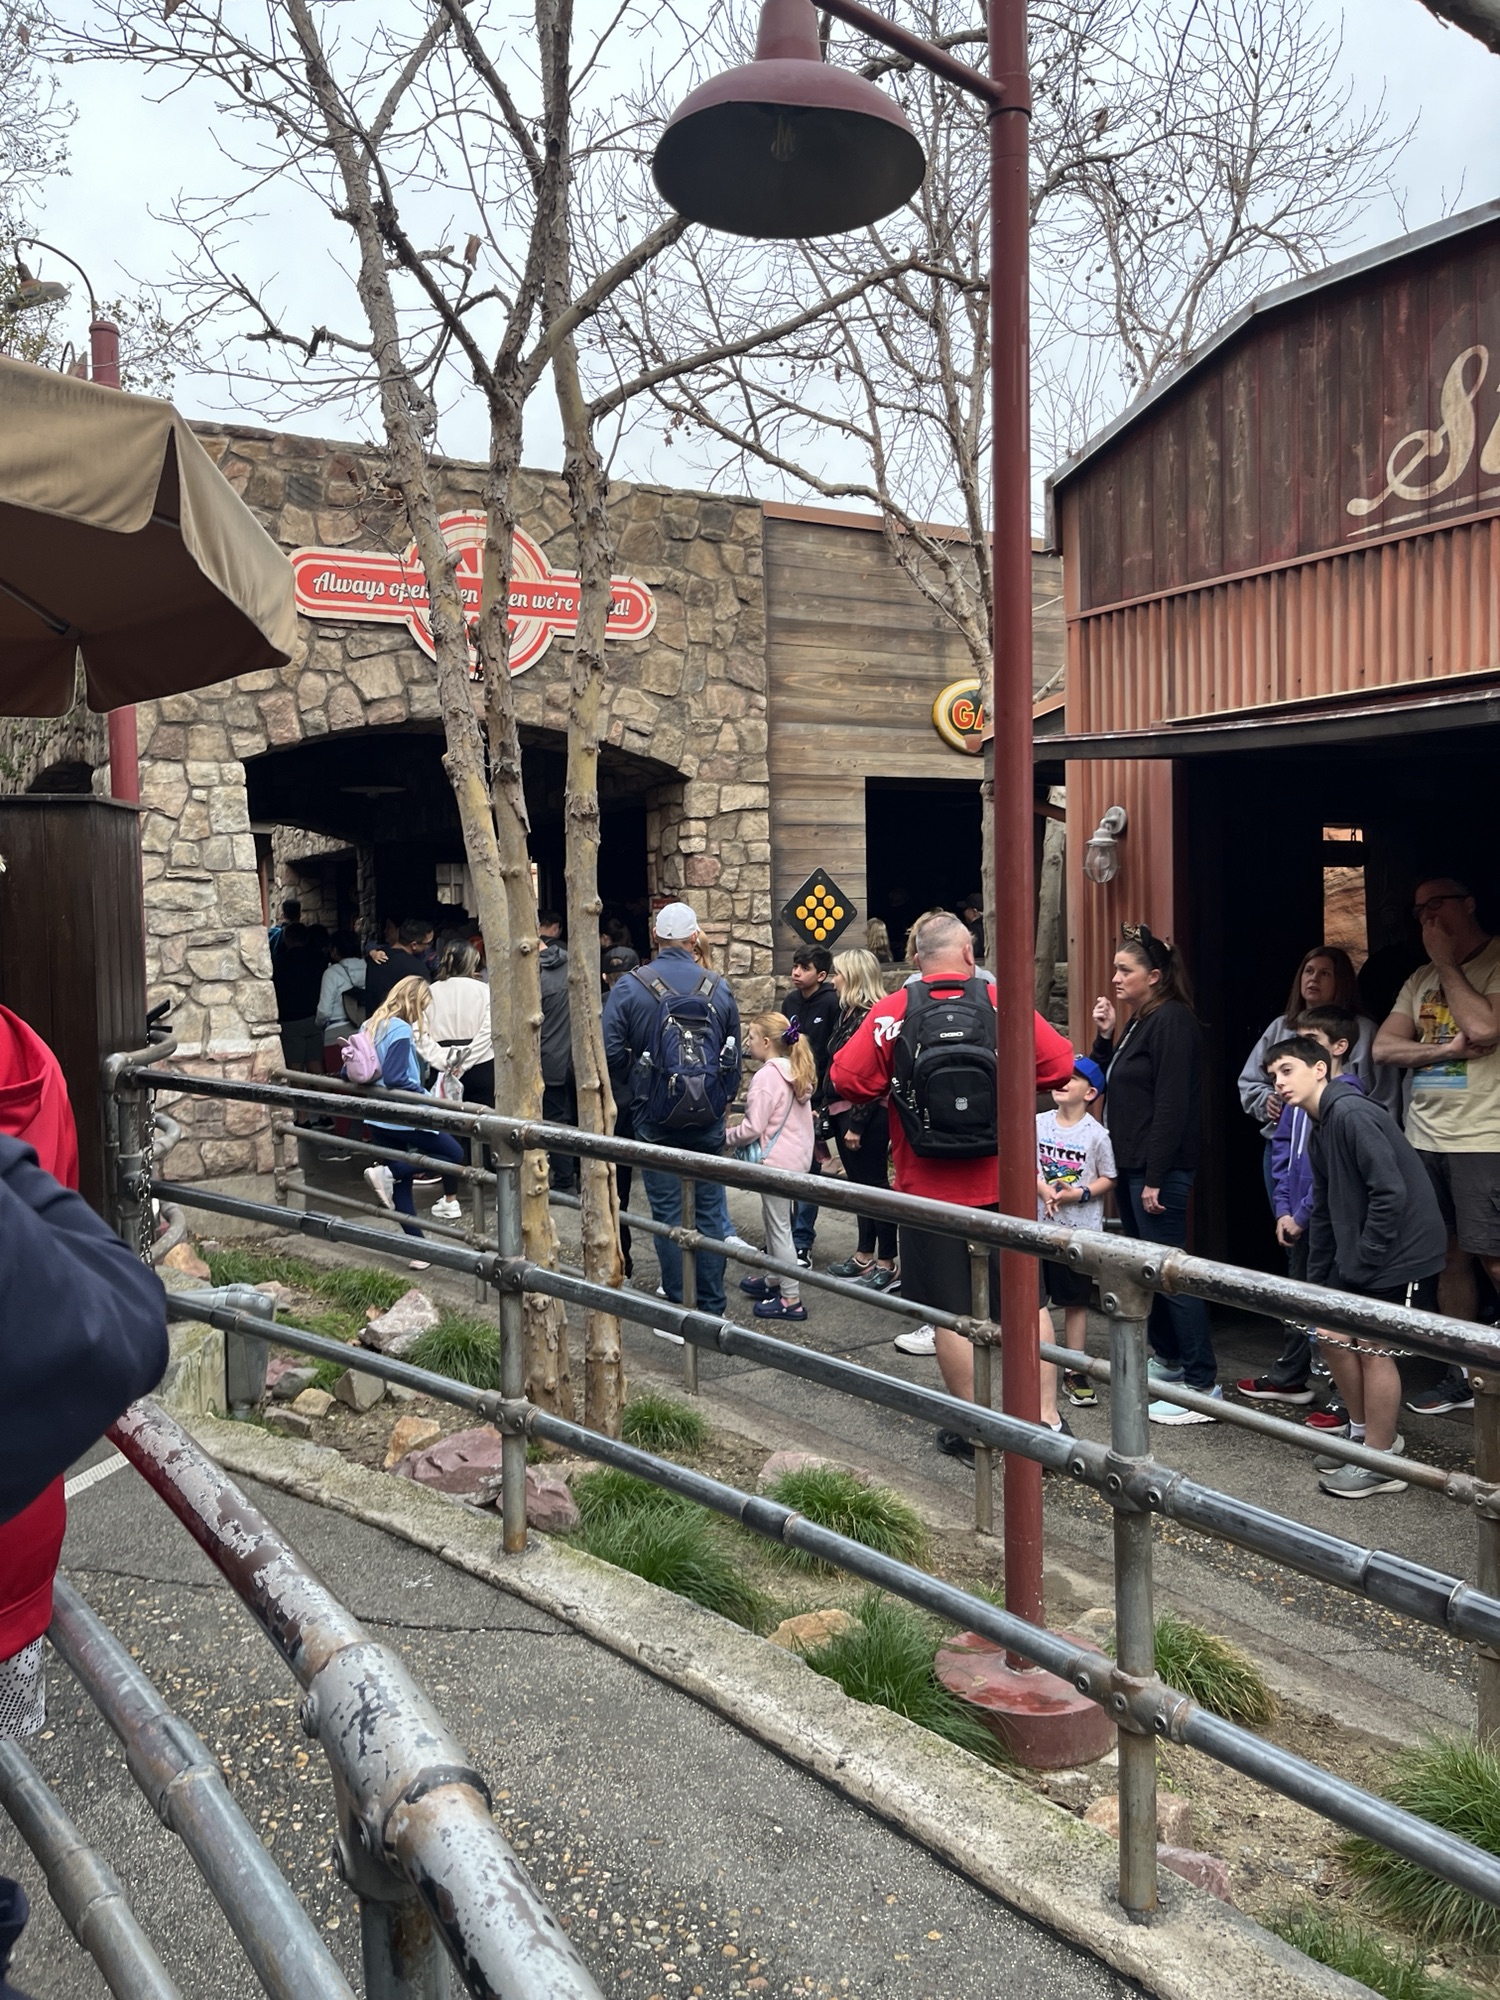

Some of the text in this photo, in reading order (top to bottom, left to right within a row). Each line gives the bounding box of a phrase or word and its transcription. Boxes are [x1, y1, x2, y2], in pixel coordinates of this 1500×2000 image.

[1346, 344, 1500, 516] S
[313, 571, 385, 601] Always
[531, 591, 574, 612] we're
[1039, 1142, 1087, 1162] STITCH
